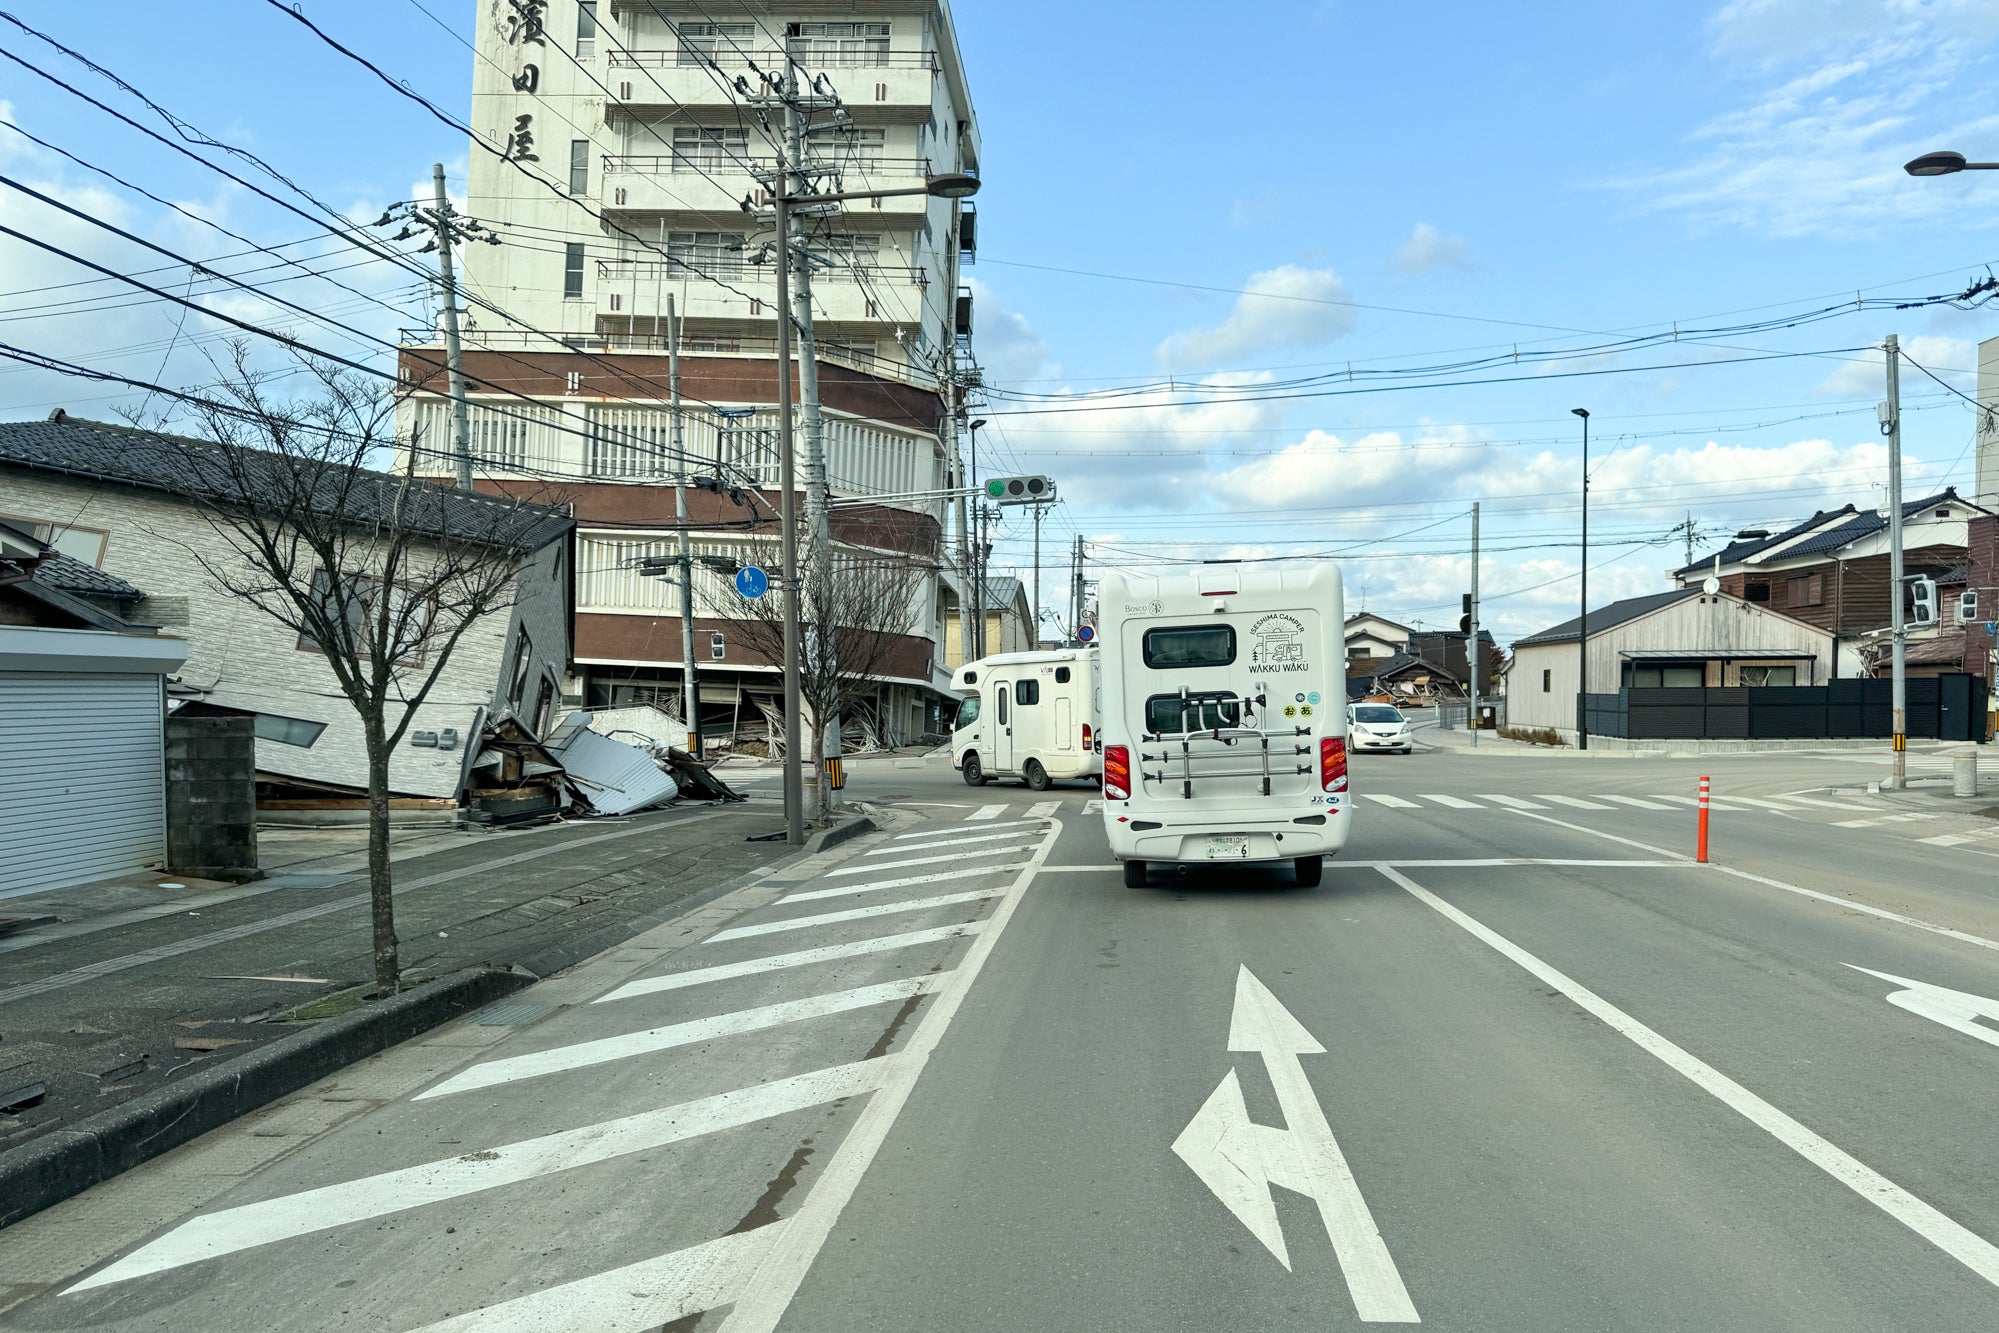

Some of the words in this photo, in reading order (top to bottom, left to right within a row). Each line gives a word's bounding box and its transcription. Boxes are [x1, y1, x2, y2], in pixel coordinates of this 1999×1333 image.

[1249, 613, 1278, 635] ISESHIMA
[1279, 613, 1305, 633] CAMPER
[1248, 664, 1281, 674] WAKKU
[1282, 662, 1309, 672] WAKU
